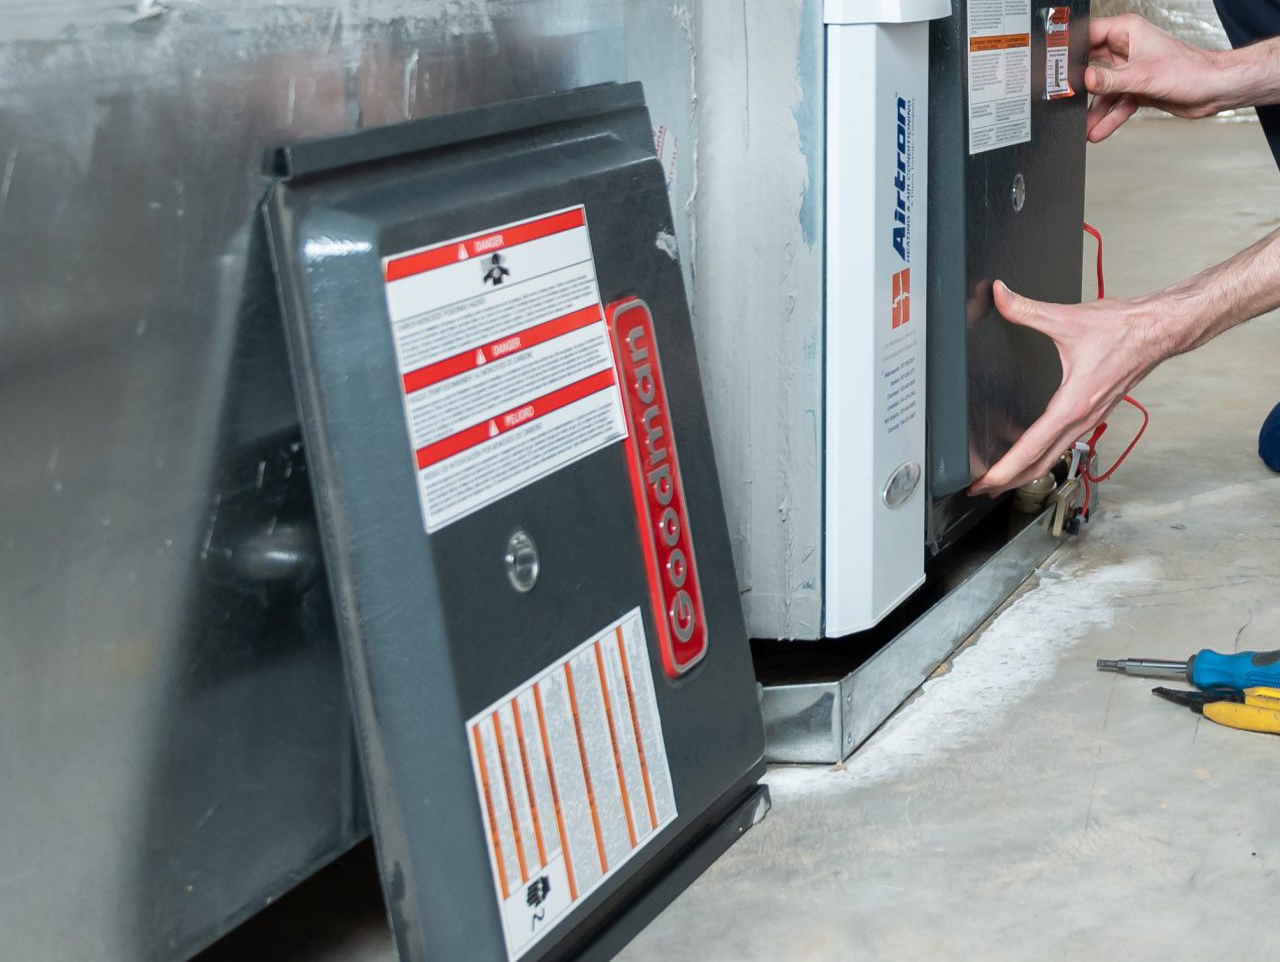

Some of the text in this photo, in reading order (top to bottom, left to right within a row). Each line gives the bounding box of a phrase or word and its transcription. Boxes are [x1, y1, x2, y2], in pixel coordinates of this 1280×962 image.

[893, 97, 906, 262] Airtron
[475, 235, 504, 253] DANGER
[492, 337, 522, 357] DANGER
[504, 406, 535, 427] PELIGRO
[626, 325, 695, 643] Goodman
